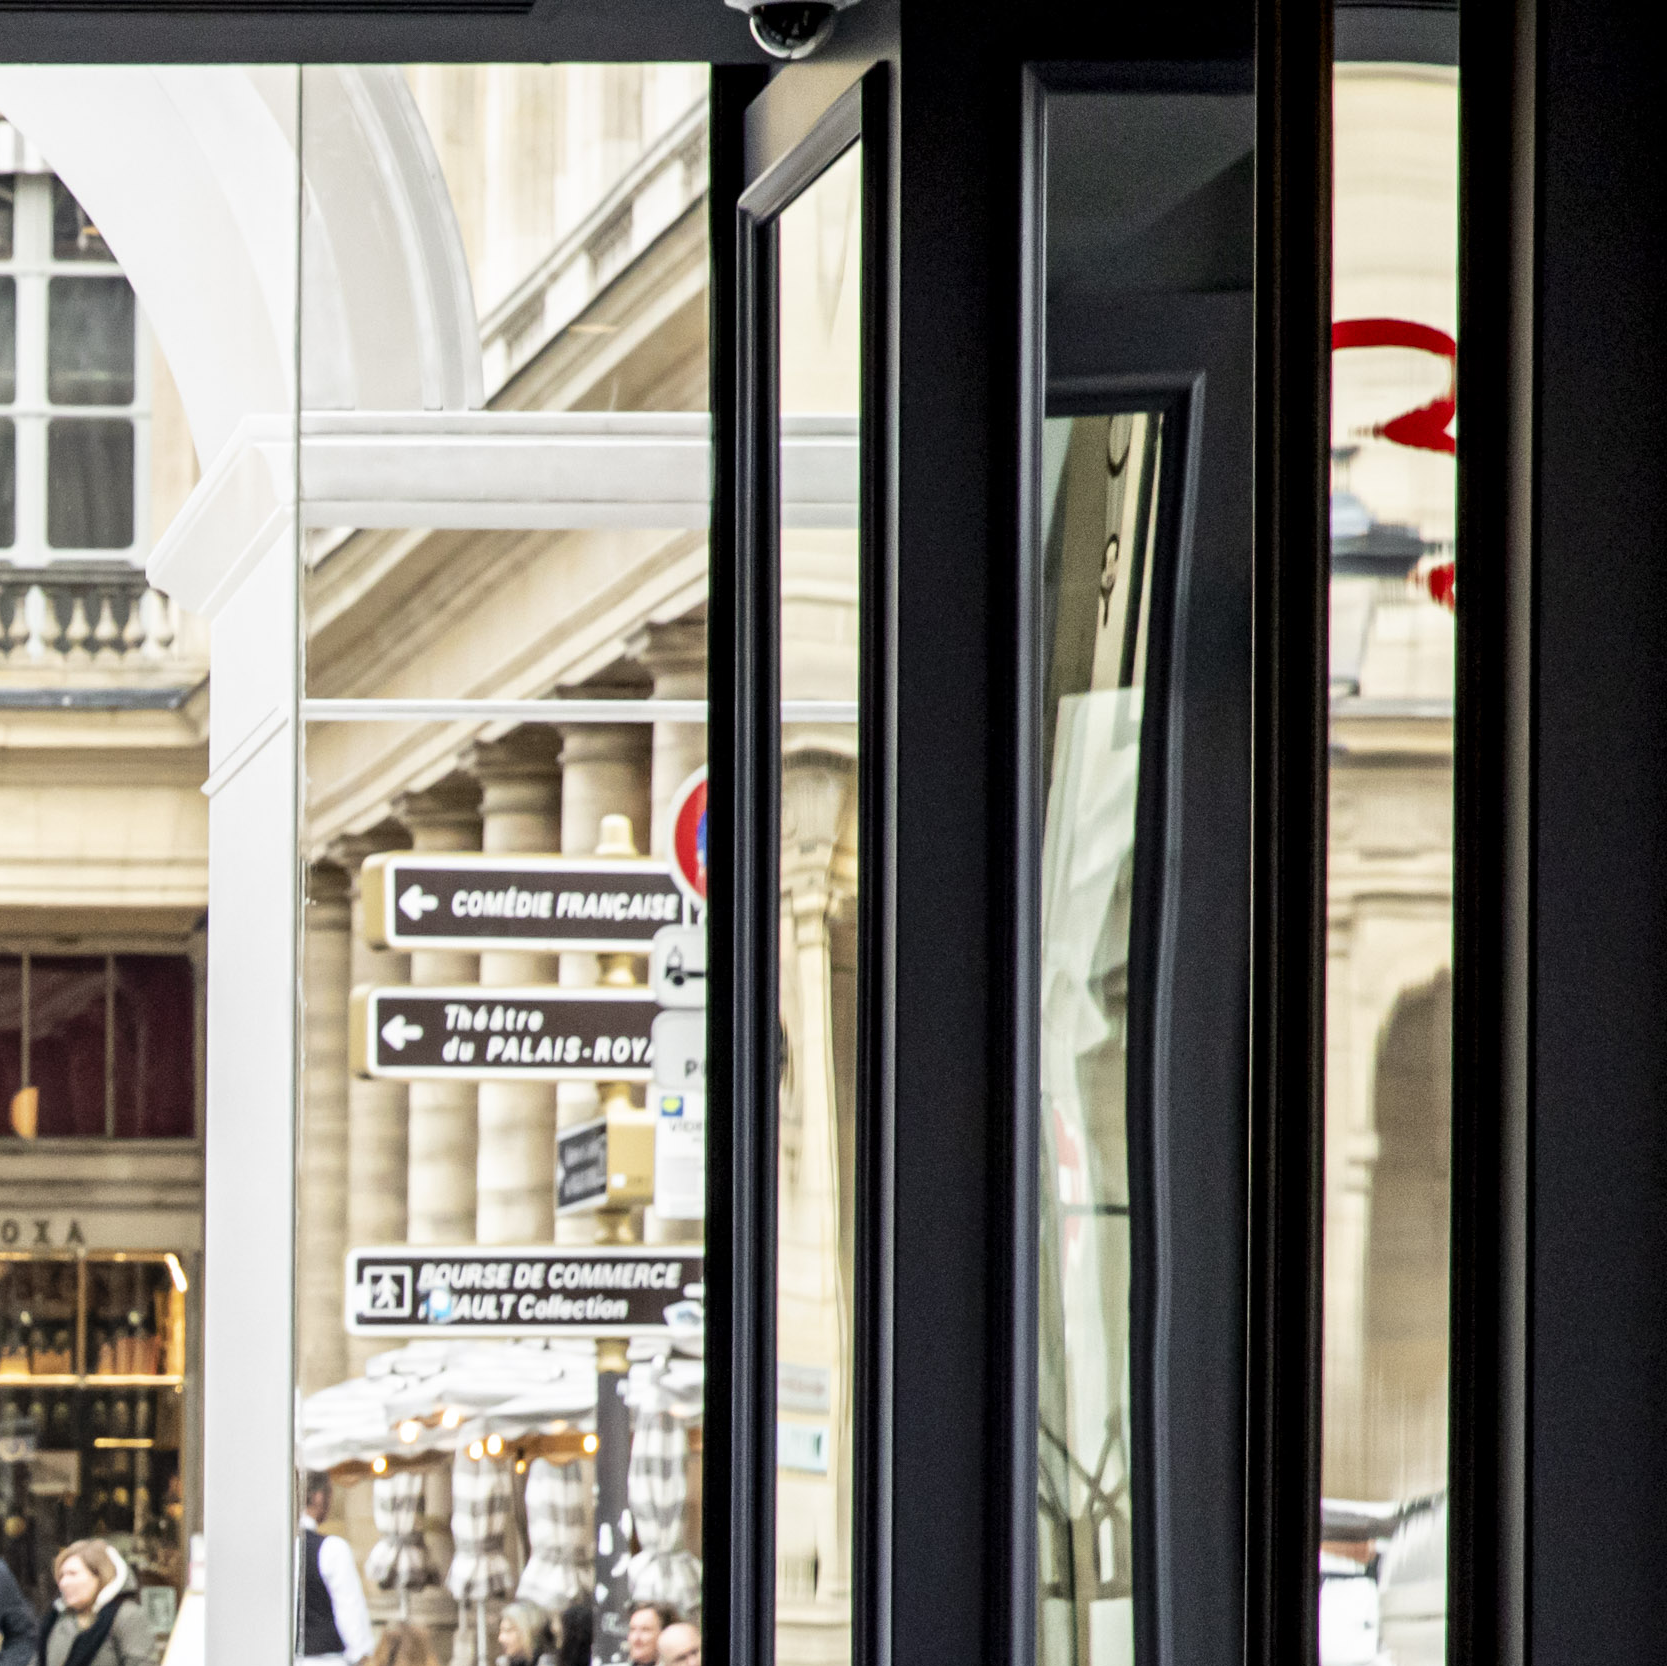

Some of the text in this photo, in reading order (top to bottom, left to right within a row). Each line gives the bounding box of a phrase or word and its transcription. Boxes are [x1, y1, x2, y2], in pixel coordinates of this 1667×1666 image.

[451, 885, 679, 921] COMÉDIE FRANÇAISE
[444, 1003, 545, 1033] Théâtre
[441, 1035, 476, 1063] du
[416, 1262, 682, 1290] BOURSE DE COMMERCE
[518, 1294, 629, 1321] Collection
